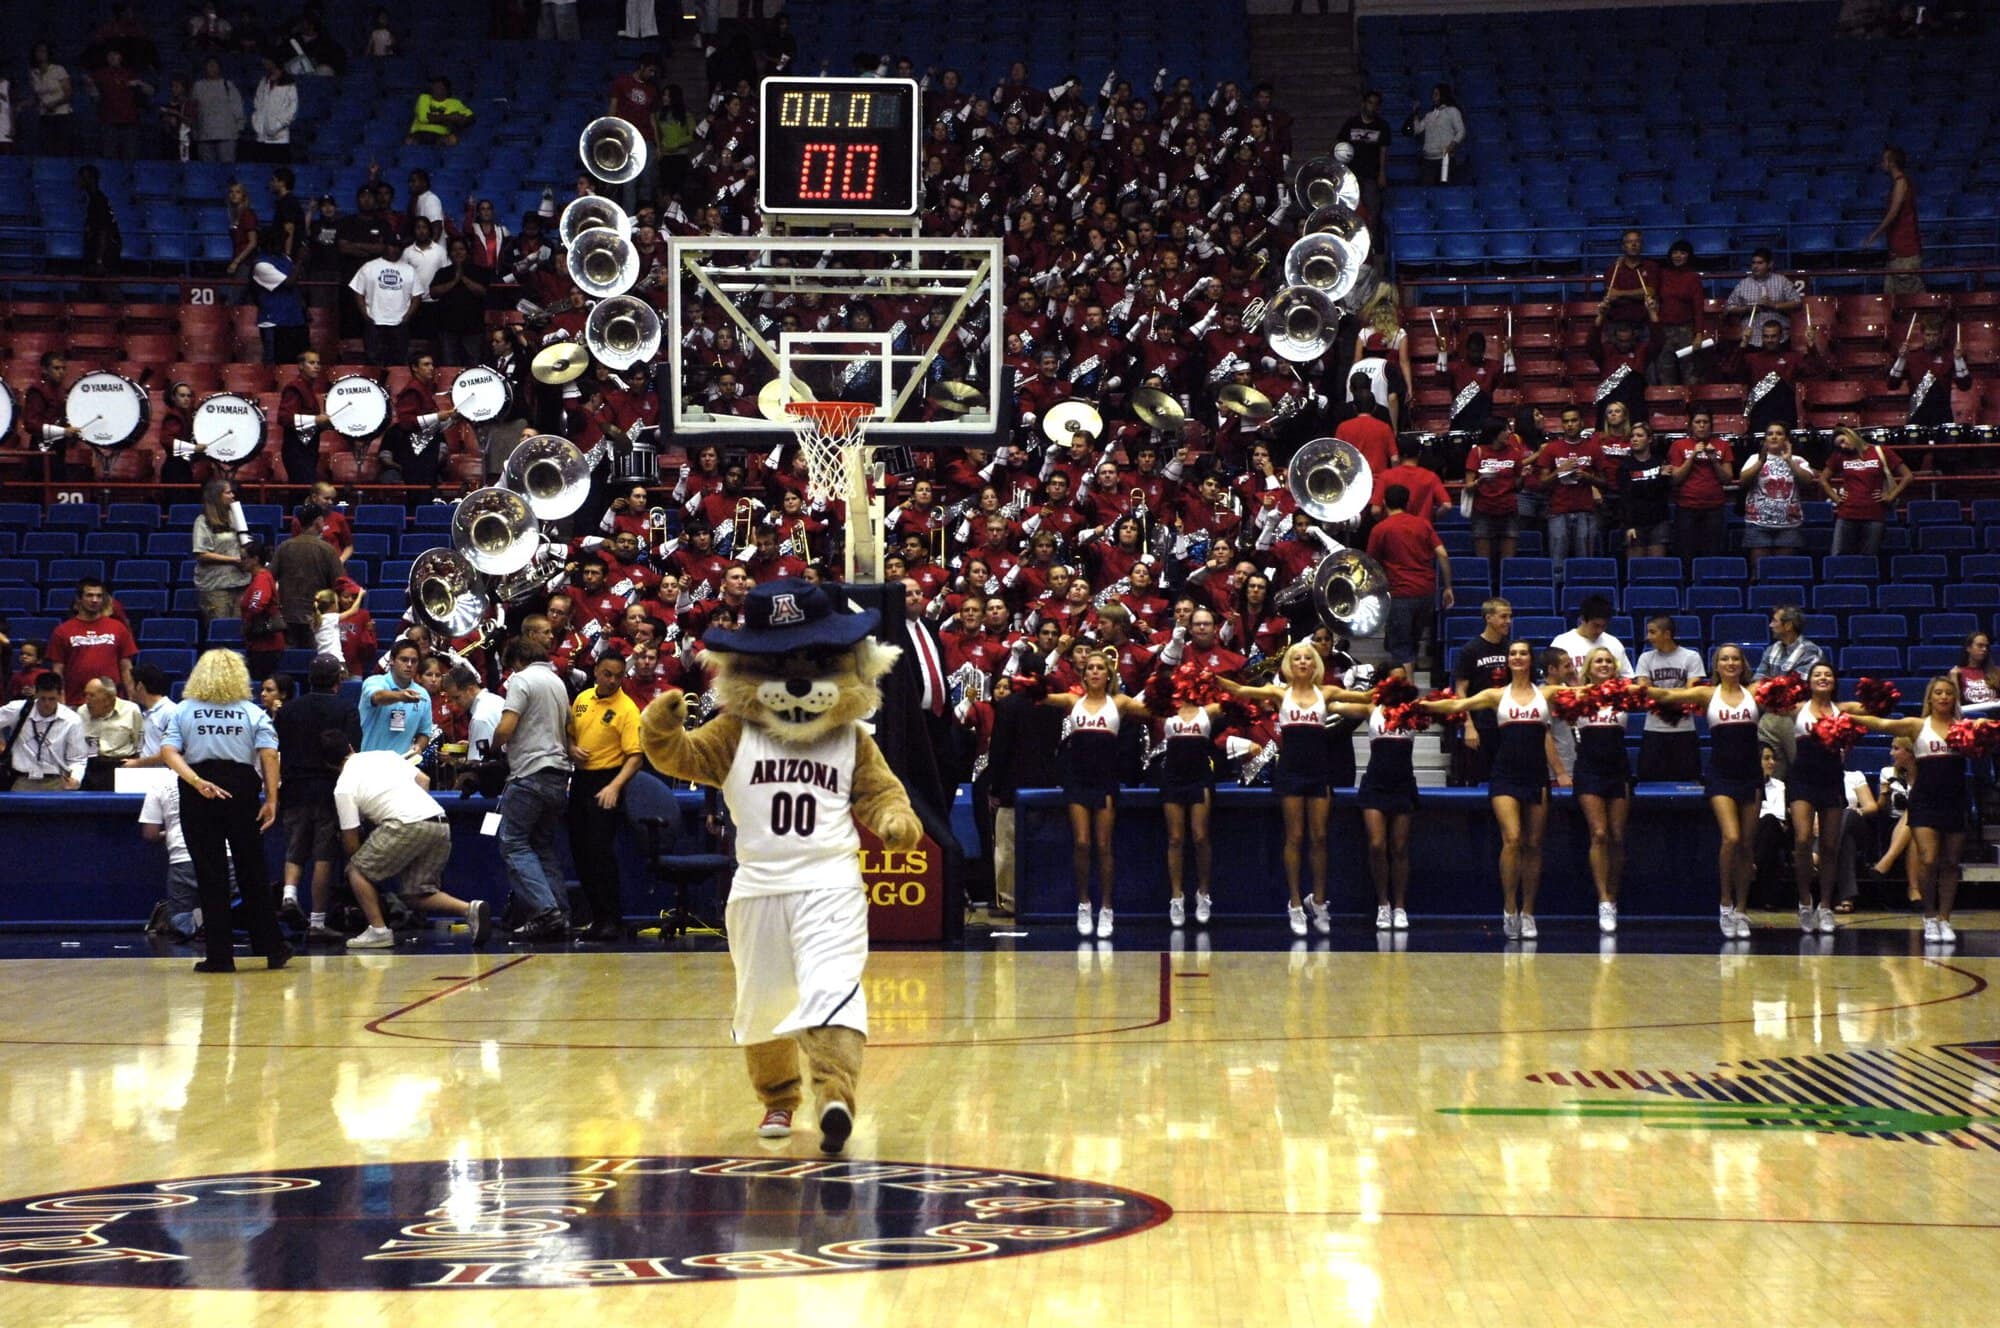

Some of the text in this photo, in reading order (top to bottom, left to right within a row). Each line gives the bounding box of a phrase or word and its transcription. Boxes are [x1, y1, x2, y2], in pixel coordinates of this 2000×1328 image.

[799, 143, 880, 200] 00
[191, 287, 215, 305] 20
[467, 375, 493, 387] YAMAHA
[90, 383, 124, 393] YAMAHA
[345, 385, 371, 394] YAMAHA
[215, 404, 249, 415] YAMAHA
[769, 593, 806, 625] A
[1476, 655, 1506, 668] ARIZO
[193, 708, 246, 721] EVENT
[198, 724, 244, 737] STAFF
[749, 759, 839, 794] ARIZONA
[771, 791, 817, 837] 00
[856, 849, 928, 875] LLS
